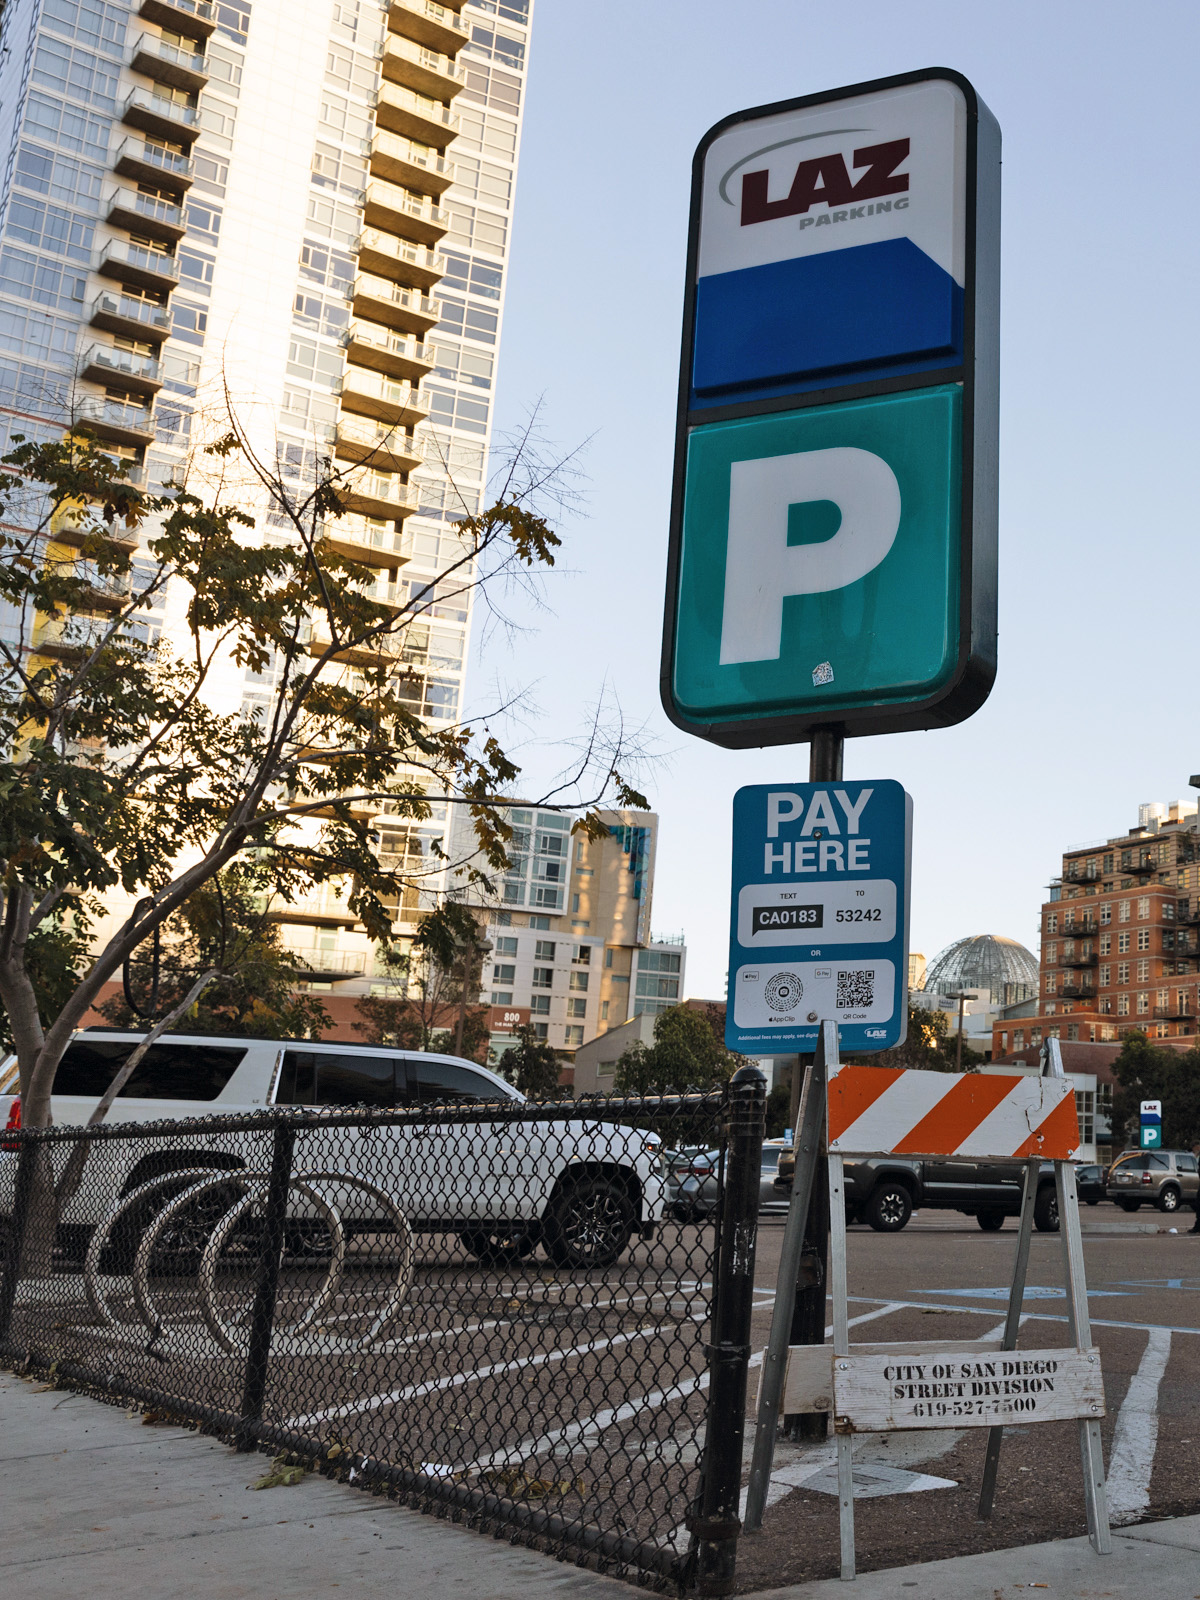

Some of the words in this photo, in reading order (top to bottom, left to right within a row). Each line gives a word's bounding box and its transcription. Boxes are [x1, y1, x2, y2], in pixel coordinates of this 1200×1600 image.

[741, 137, 910, 226] LAZ
[800, 197, 910, 230] PARKING
[719, 447, 901, 665] P
[767, 788, 874, 838] PAY
[764, 838, 871, 874] HERE
[780, 892, 797, 900] TEXT
[759, 909, 817, 925] CA0183
[836, 908, 882, 923] 53242
[810, 949, 822, 957] OR
[504, 1012, 520, 1022] 800
[866, 1029, 887, 1038] LAZ
[1143, 1128, 1158, 1146] P
[883, 1365, 928, 1381] CITY
[932, 1364, 956, 1379] OF
[960, 1362, 997, 1378] SAN
[1002, 1360, 1058, 1376] DIEGO
[894, 1382, 966, 1399] STREET
[971, 1377, 1055, 1396] DIVISION
[913, 1397, 1036, 1417] 619-527-7500
